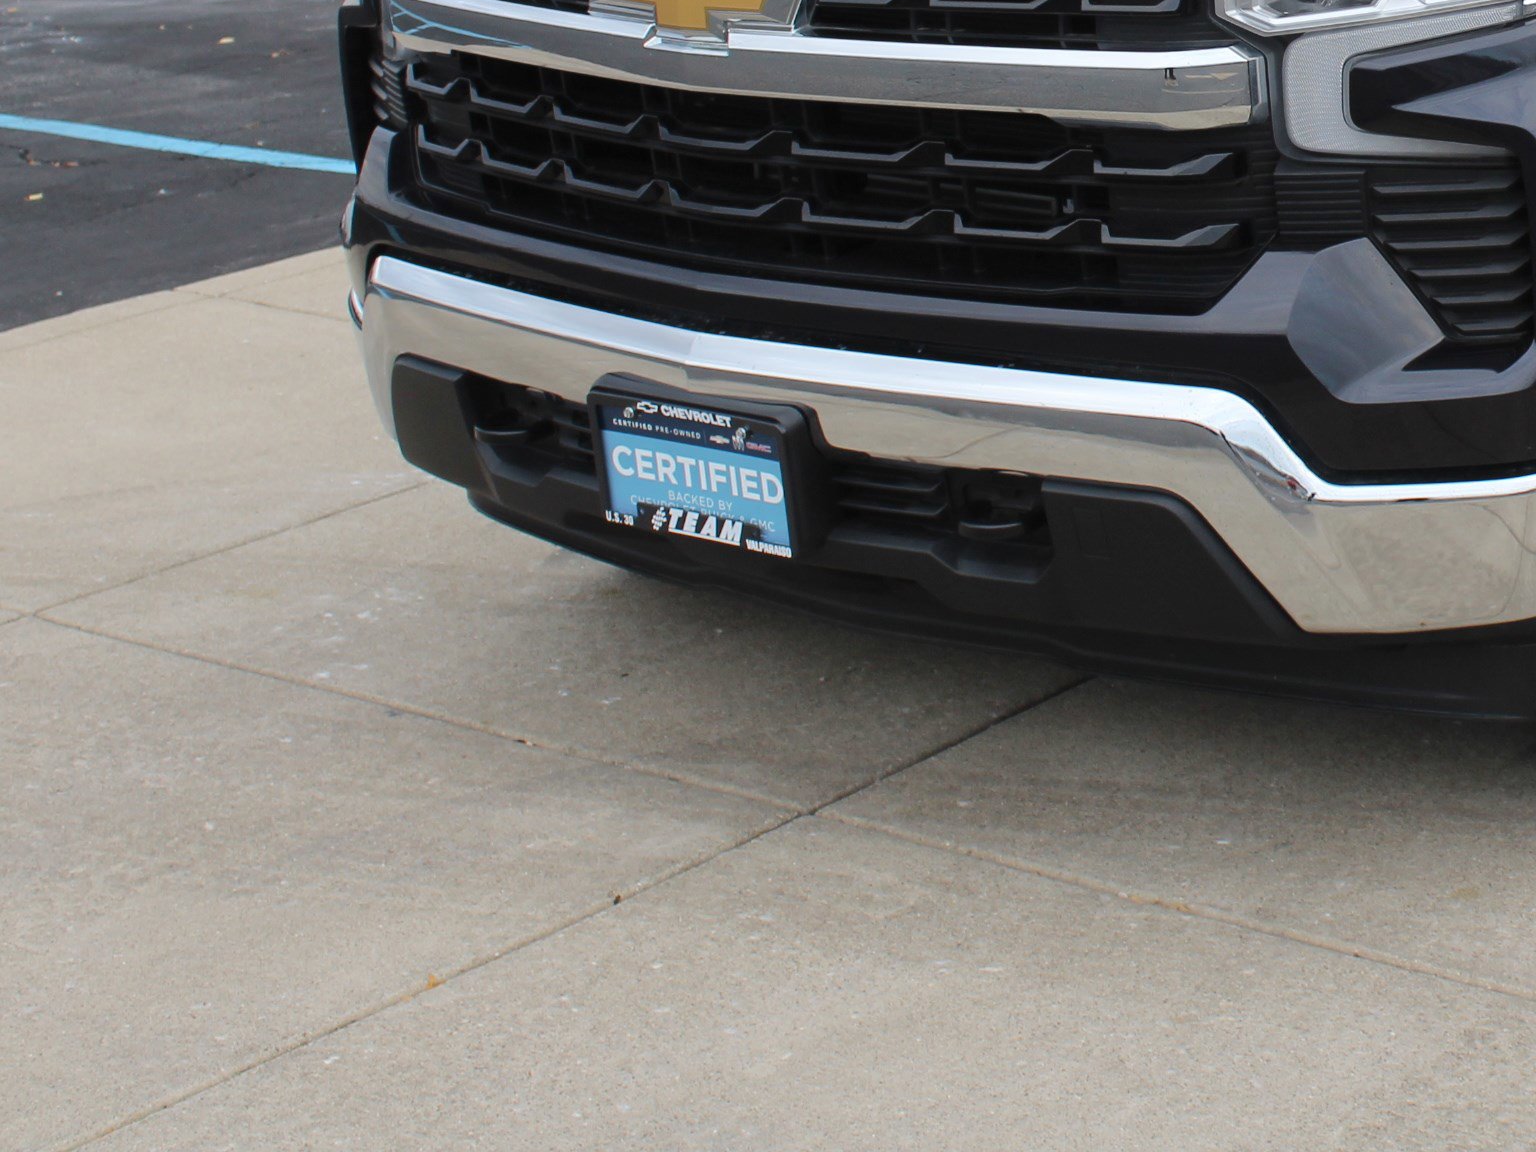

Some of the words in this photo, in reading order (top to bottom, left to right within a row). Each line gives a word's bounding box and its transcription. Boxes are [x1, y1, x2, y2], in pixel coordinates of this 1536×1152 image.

[660, 404, 732, 428] CHEVROLET
[612, 417, 653, 432] CERTIFIED
[655, 425, 701, 440] PRE-OWNED
[612, 445, 784, 505] CERTIFIED
[668, 489, 714, 508] BACKED
[719, 499, 733, 511] BY
[605, 510, 623, 524] U.S.
[624, 513, 635, 526] 30
[668, 507, 743, 544] TEAM
[745, 539, 792, 558] VALPARAISO
